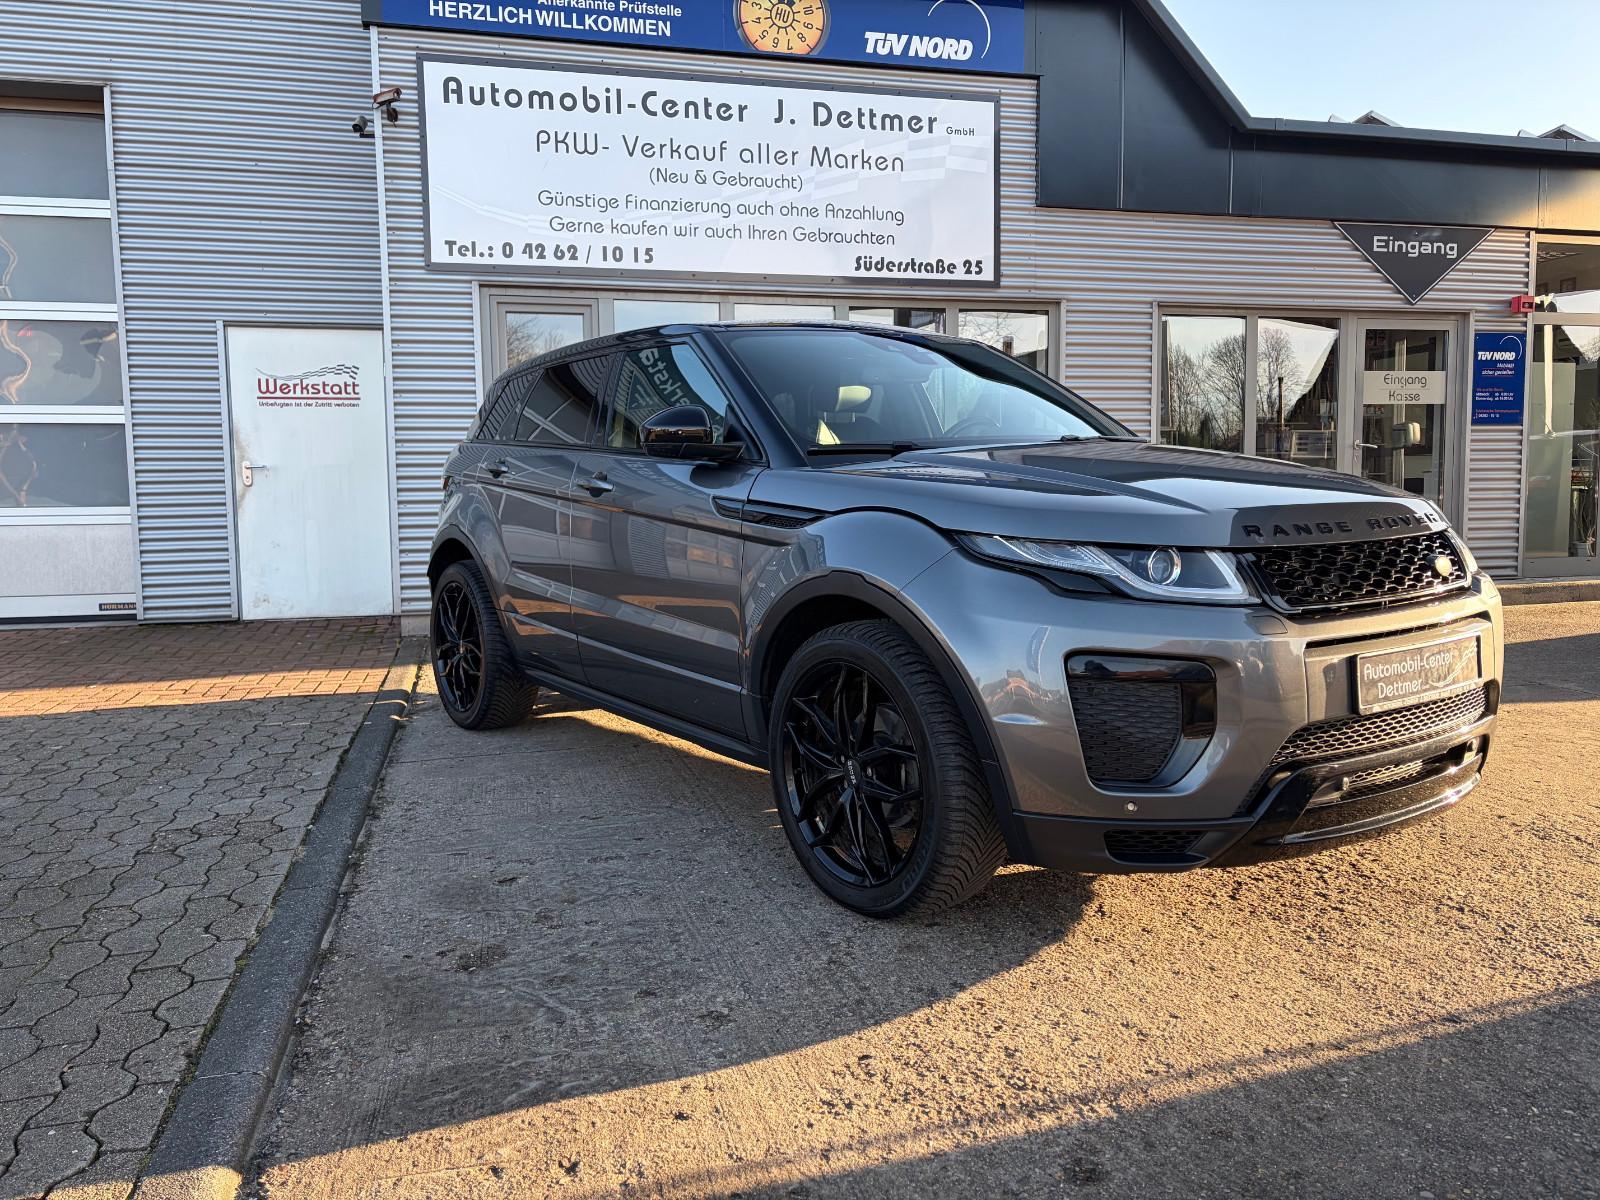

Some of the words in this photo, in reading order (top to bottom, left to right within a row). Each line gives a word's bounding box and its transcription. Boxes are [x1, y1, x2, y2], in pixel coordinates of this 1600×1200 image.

[619, 1, 682, 17] Prüfstelle
[752, 2, 762, 10] 3
[775, 7, 790, 24] HU
[803, 5, 814, 16] 10
[428, 0, 533, 25] HERZLICH
[535, 10, 671, 37] WILLKOMMEN
[759, 29, 769, 40] 5
[797, 32, 806, 43] 8
[864, 31, 910, 56] TÜV
[908, 38, 974, 61] NORD
[442, 76, 749, 122] Automobil-Center
[773, 98, 796, 125] J.
[812, 101, 938, 134] Dettmer
[946, 126, 976, 137] GmbH
[536, 129, 610, 156] PKW-
[622, 134, 728, 162] Verkauf
[739, 142, 800, 166] aller
[810, 145, 905, 172] Marken
[649, 167, 689, 186] (Neu
[694, 169, 708, 185] &
[712, 170, 804, 192] Gebraucht)
[537, 189, 620, 213] Günstige
[625, 193, 731, 218] Finanzierung
[736, 200, 774, 217] auch
[779, 201, 820, 218] ohne
[825, 203, 905, 226] Anzahlung
[549, 215, 605, 234] Gerne
[610, 218, 668, 237] kaufen
[674, 223, 700, 238] wir
[704, 224, 742, 240] auch
[748, 225, 788, 241] Ihren
[792, 226, 896, 246] Gebrauchten
[444, 239, 495, 258] Tel.:
[501, 241, 514, 260] 0
[1372, 235, 1458, 259] Eingang
[854, 255, 958, 275] Süderstraße
[962, 259, 984, 276] 25
[1492, 351, 1516, 361] NORD
[257, 378, 360, 395] Werkstatt
[1383, 373, 1428, 388] Eingang
[258, 401, 293, 409] Unbefugten
[1388, 390, 1421, 402] Kasse
[1241, 520, 1353, 539] RANGE
[1366, 511, 1440, 531] ROVER
[1363, 650, 1454, 681] Automobil-Center
[1377, 679, 1422, 699] Dettmer
